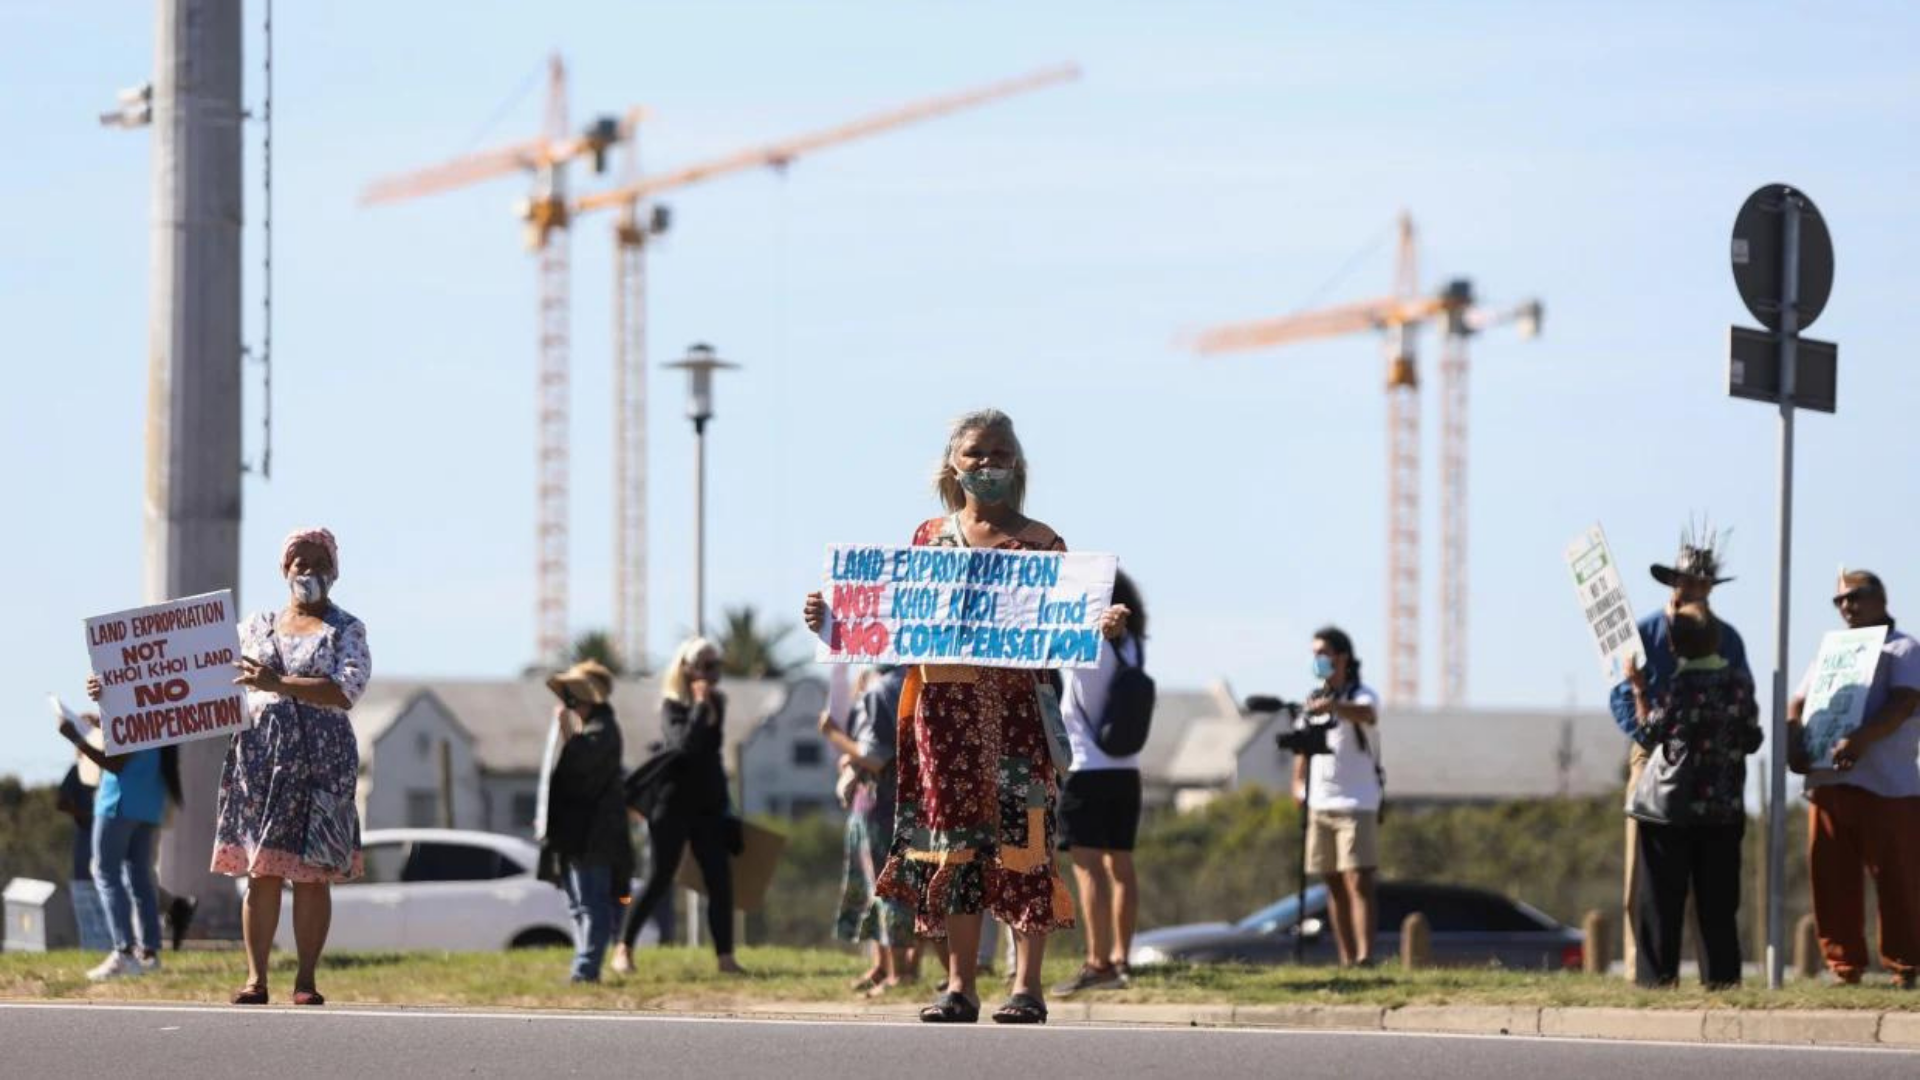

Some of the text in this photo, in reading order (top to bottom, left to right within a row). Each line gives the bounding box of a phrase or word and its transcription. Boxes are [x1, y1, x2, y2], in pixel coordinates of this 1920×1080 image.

[832, 549, 1061, 587] LAND EXPROPRIATION
[90, 600, 225, 646] LAND EXPROPRIATION
[831, 584, 1088, 625] NOT KHOI KHOI land
[121, 639, 168, 666] NOT
[830, 620, 1100, 662] NO COMPENSATION
[103, 648, 233, 686] KHOI KHOI LAND
[134, 678, 190, 708] NO
[111, 695, 242, 746] COMPENSATION
